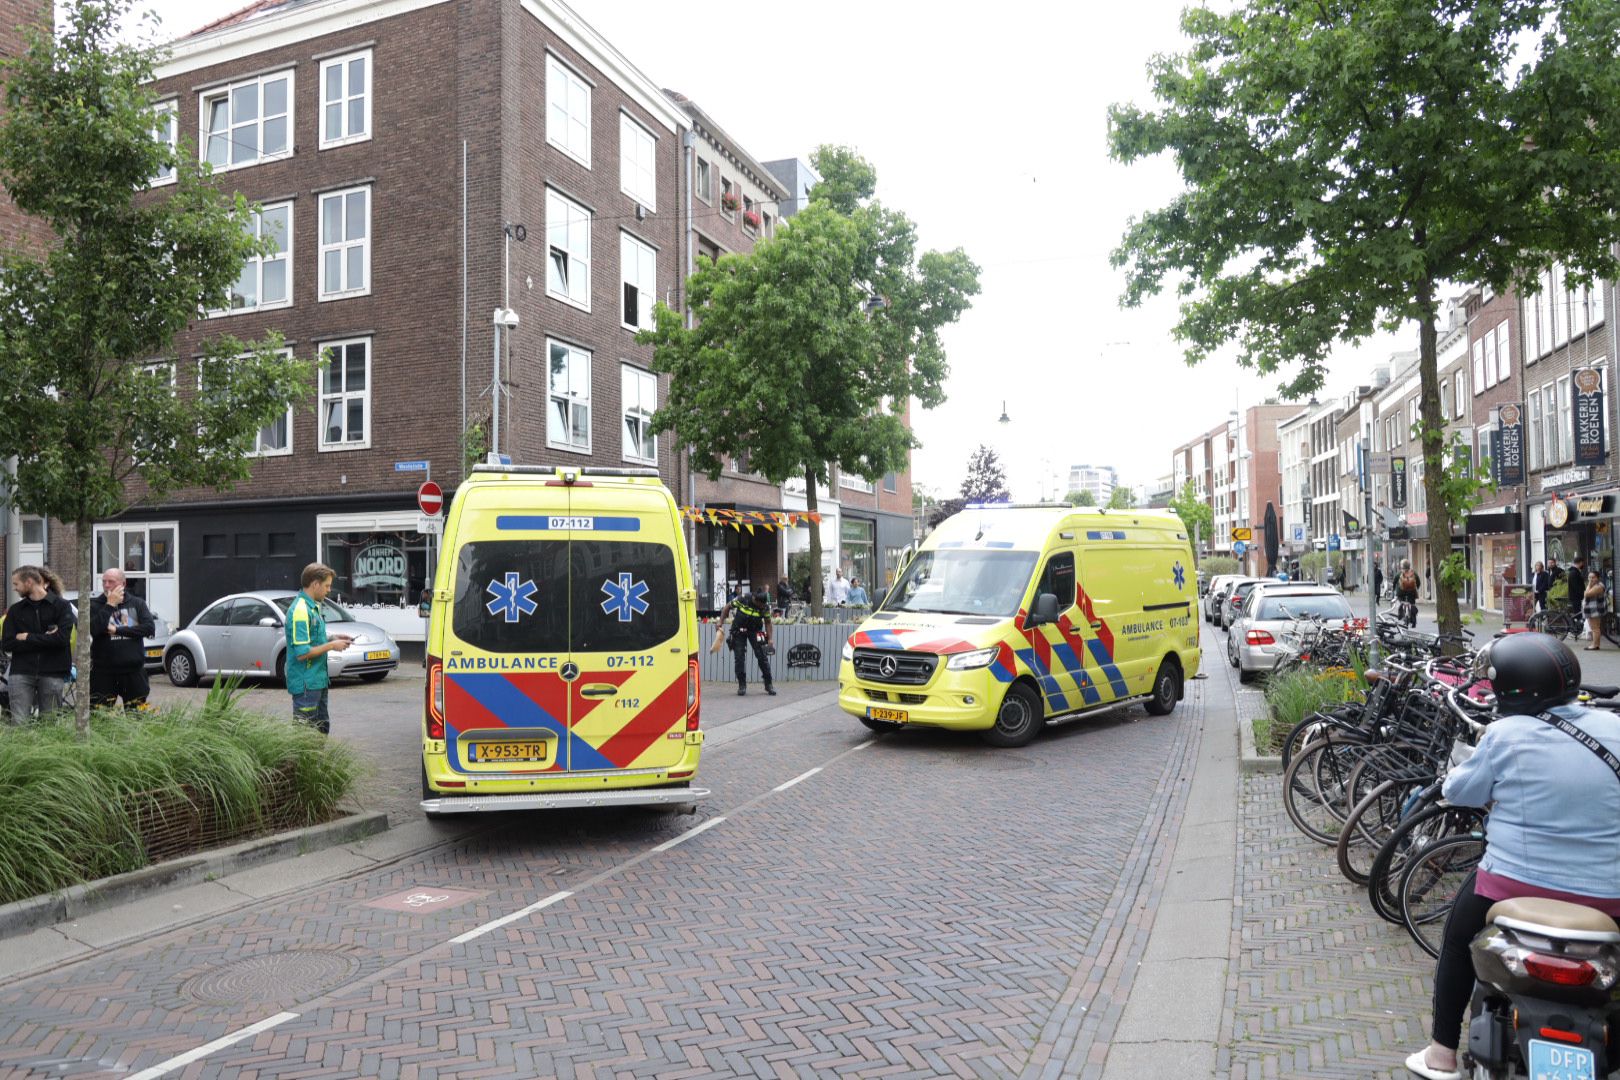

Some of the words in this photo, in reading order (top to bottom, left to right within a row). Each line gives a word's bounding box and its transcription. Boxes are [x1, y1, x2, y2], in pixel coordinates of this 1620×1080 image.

[1579, 398, 1589, 444] BAKKERIJ
[1589, 397, 1600, 444] KOENEN
[1503, 429, 1511, 467] BAKKERIJ
[1511, 428, 1520, 467] KOENEN
[551, 518, 590, 528] 07-112
[357, 556, 405, 576] NOORD
[1121, 620, 1164, 635] AMBULANCE
[447, 657, 558, 669] AMBULANCE
[606, 655, 654, 667] 07-112
[790, 651, 819, 661] NOORD
[621, 698, 640, 709] 112
[1576, 732, 1586, 740] IT
[1584, 737, 1600, 750] GET
[481, 744, 541, 758] X-953-TR
[1550, 1047, 1587, 1071] DFP
